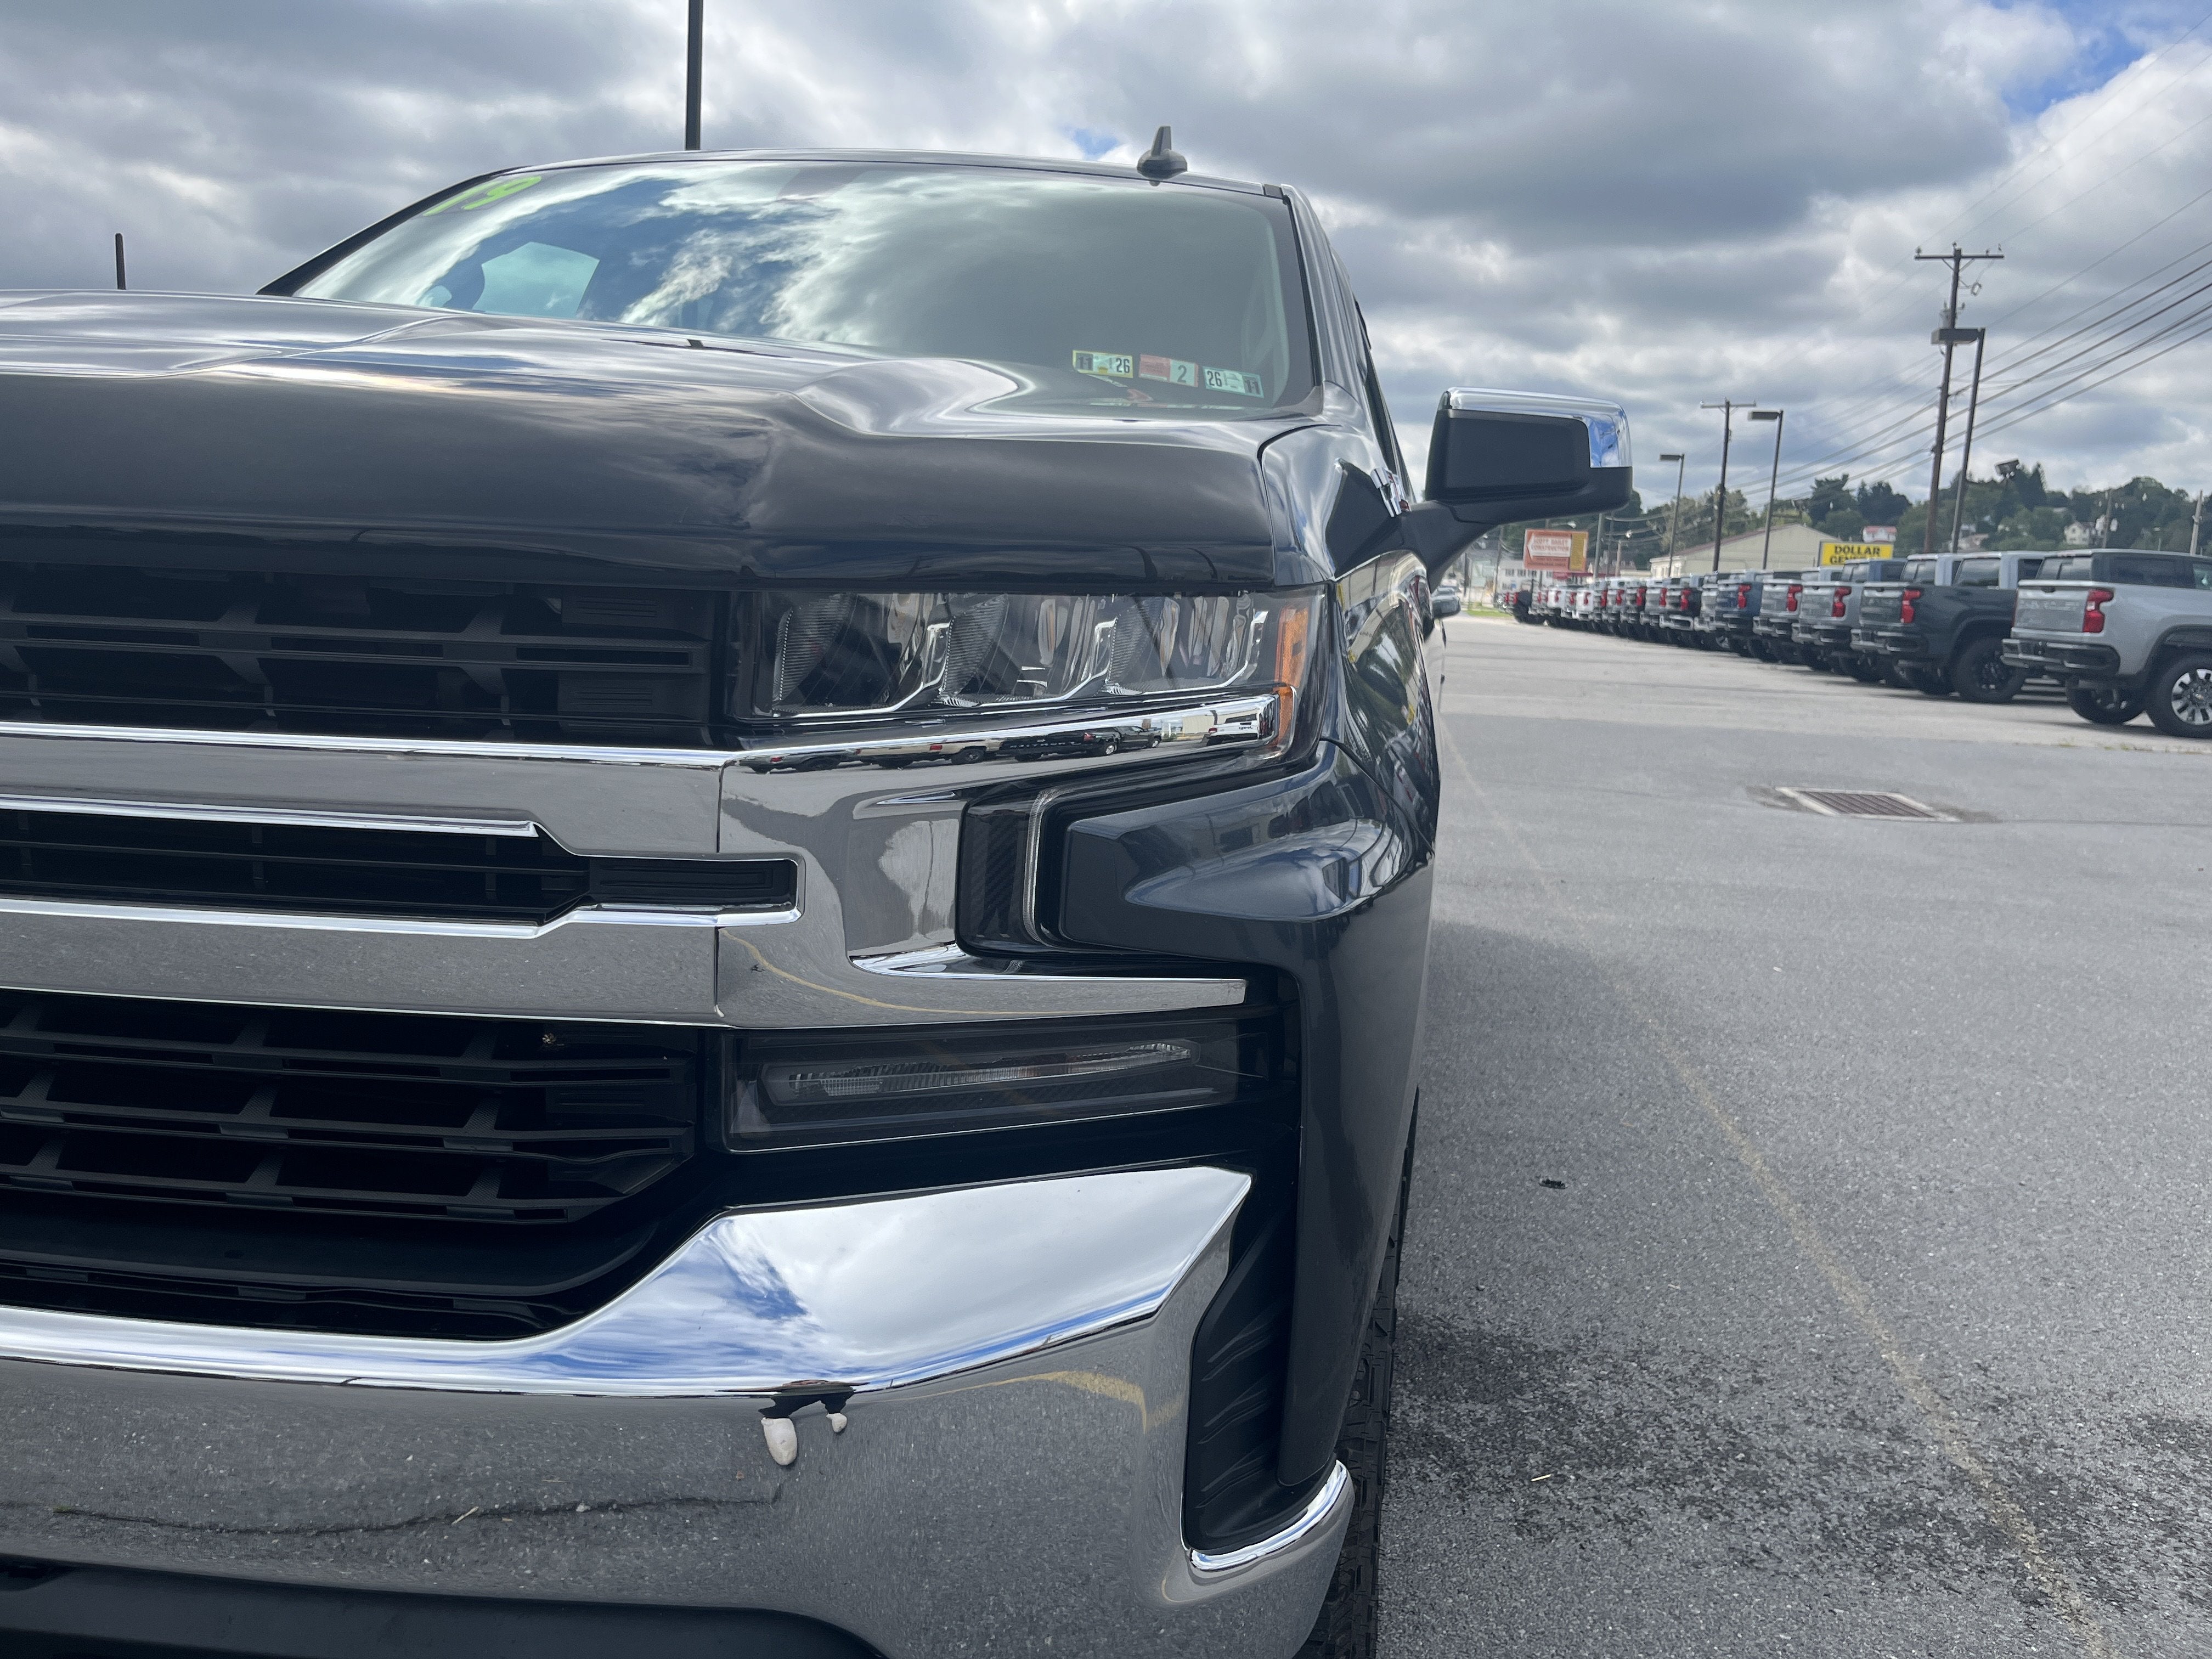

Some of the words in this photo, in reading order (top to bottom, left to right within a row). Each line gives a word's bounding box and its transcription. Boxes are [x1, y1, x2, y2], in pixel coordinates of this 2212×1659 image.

[1116, 358, 1130, 373] 26
[1178, 365, 1187, 383] 2
[1207, 371, 1222, 387] 26
[1835, 545, 1880, 555] DOLLAR
